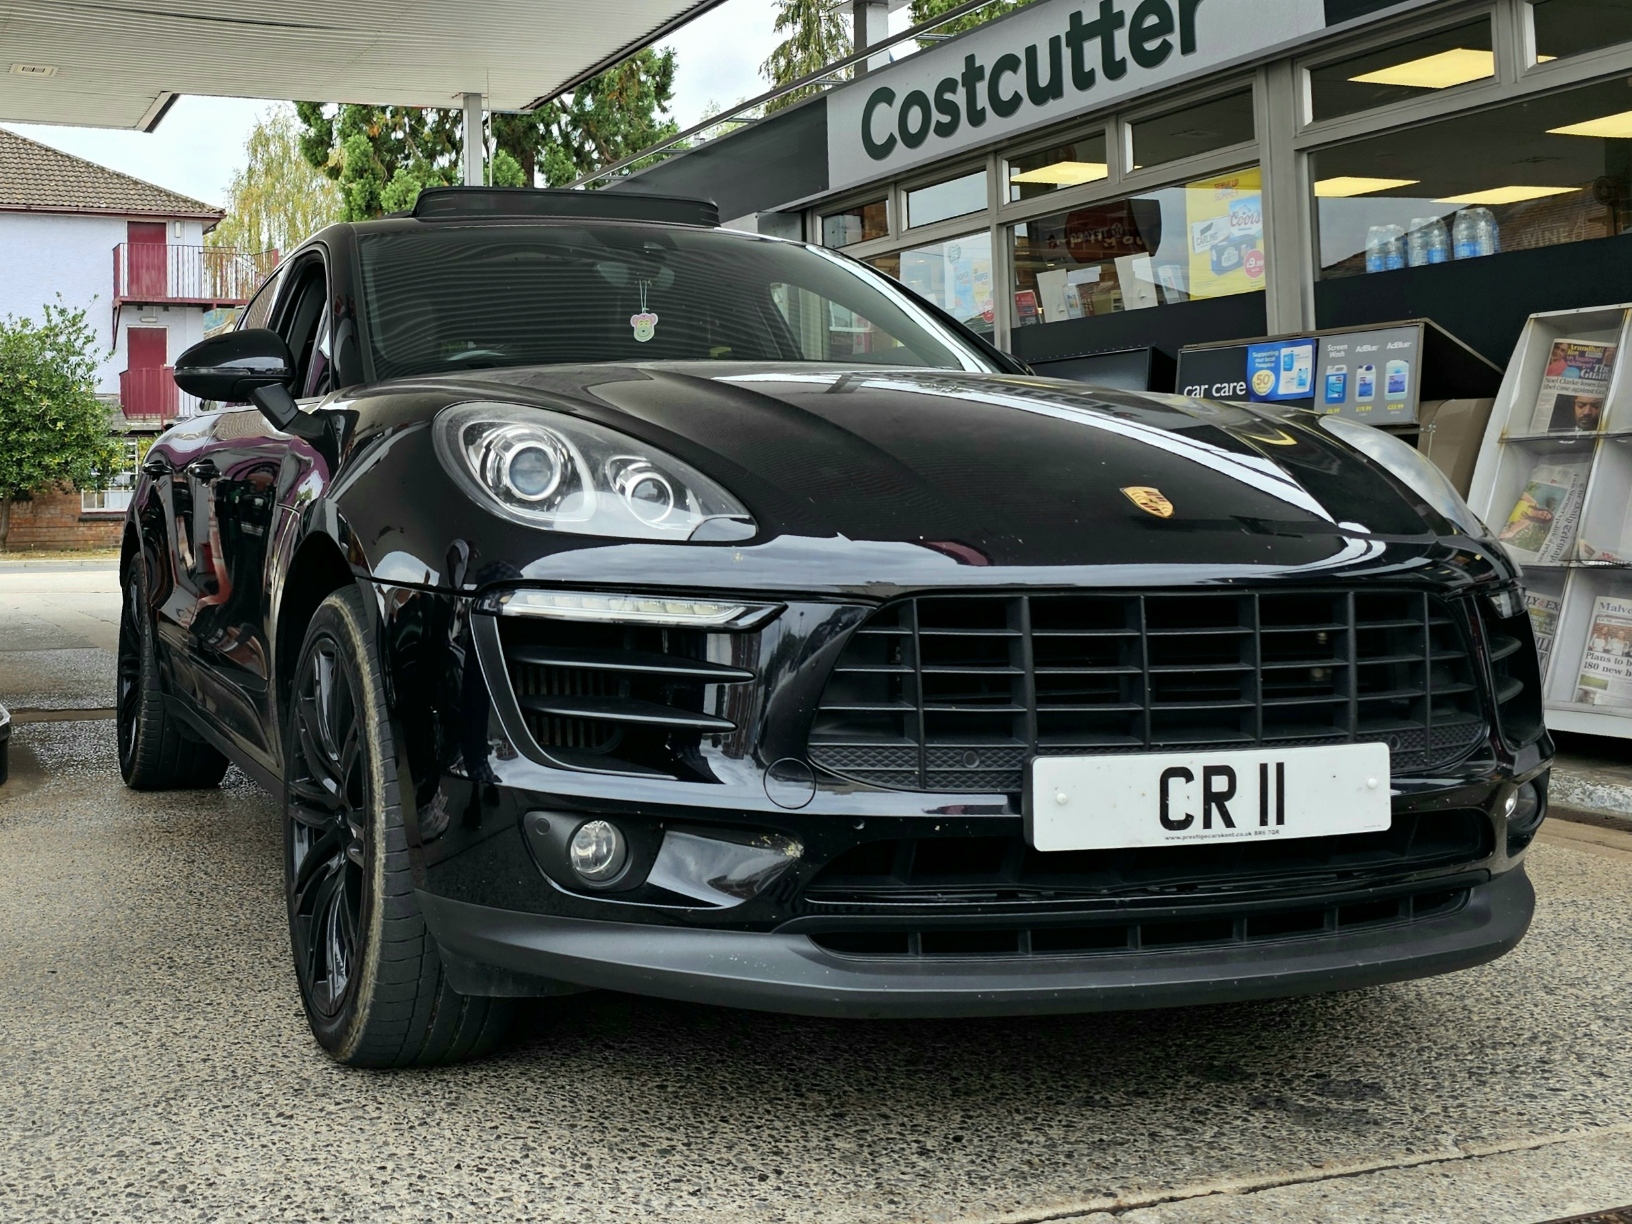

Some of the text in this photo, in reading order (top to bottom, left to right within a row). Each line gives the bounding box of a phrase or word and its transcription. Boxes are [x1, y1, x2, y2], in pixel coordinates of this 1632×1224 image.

[861, 0, 1200, 160] Costcutter
[1327, 344, 1348, 352] Screen
[1328, 350, 1345, 358] Wash
[1183, 381, 1246, 398] car care
[1585, 651, 1611, 664] Plans
[1614, 656, 1623, 666] to
[1583, 661, 1600, 671] 180
[1602, 665, 1623, 676] new
[1159, 765, 1237, 832] CR
